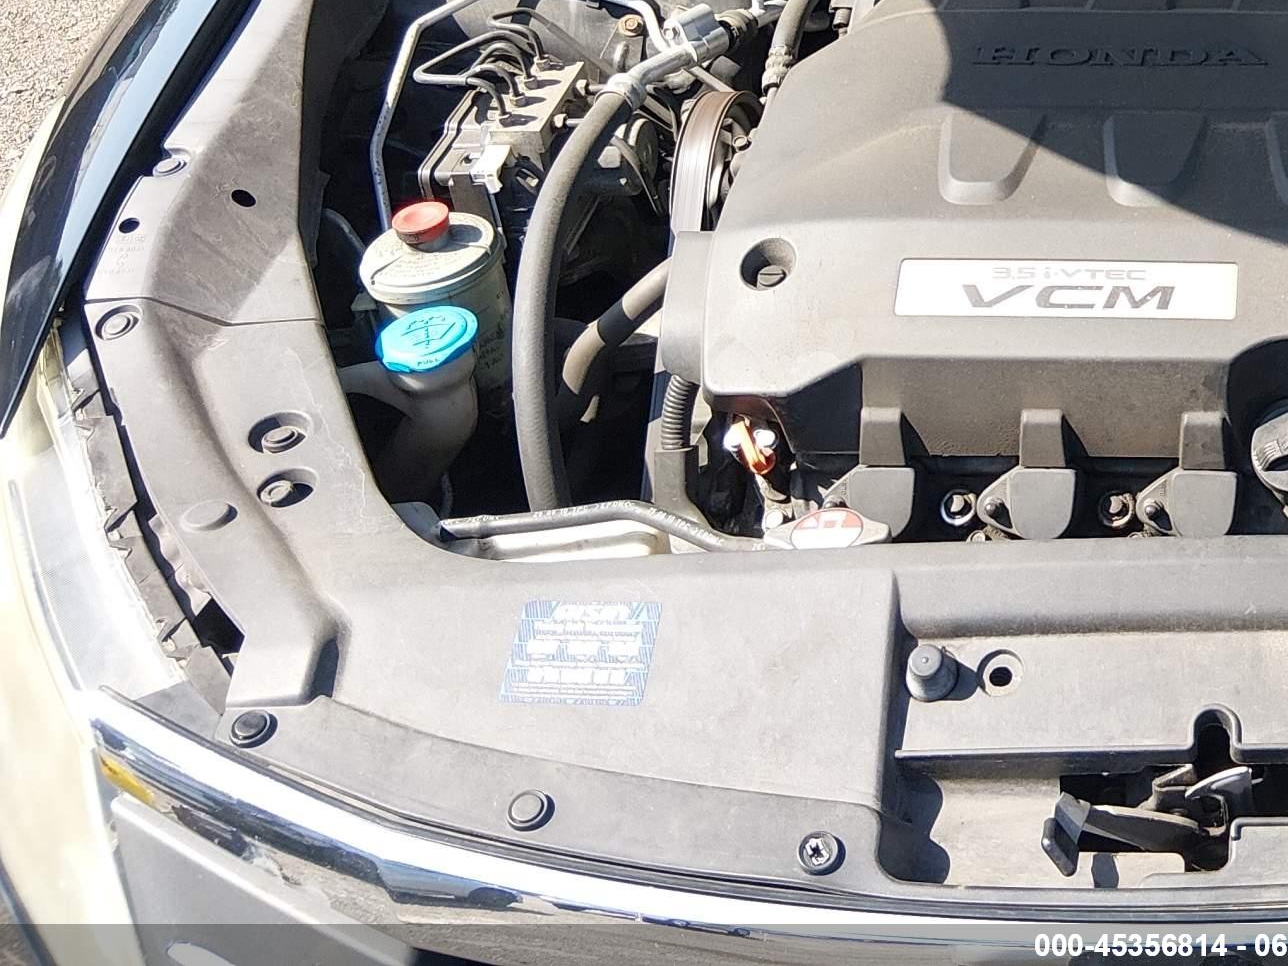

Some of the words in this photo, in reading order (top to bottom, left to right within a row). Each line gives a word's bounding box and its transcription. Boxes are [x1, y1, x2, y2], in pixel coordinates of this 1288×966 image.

[972, 46, 1268, 67] HONDA
[992, 266, 1036, 281] 3.5
[962, 283, 1176, 310] VCM
